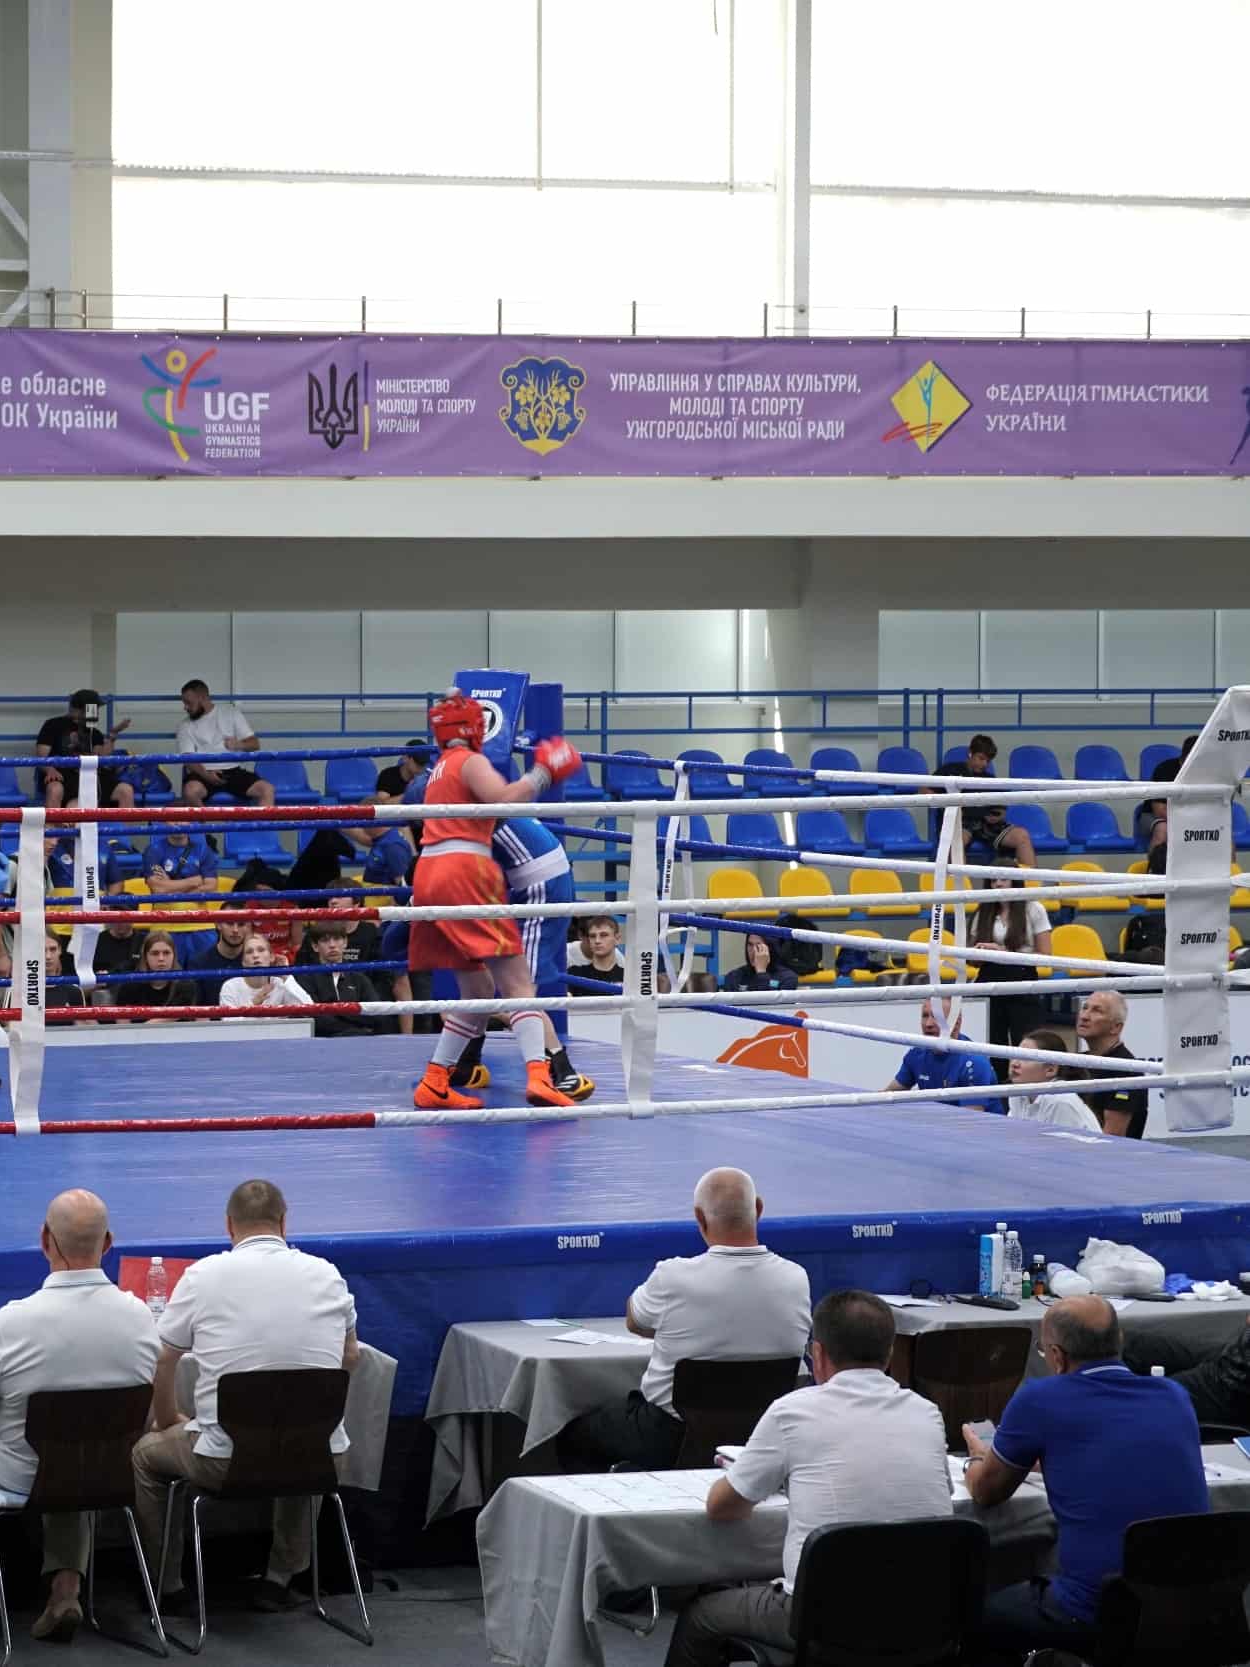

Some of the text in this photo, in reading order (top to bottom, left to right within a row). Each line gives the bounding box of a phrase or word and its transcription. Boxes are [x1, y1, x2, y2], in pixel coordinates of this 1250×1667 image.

[21, 372, 106, 396] обласне
[376, 379, 450, 393] МІНІСТЕРСТВО
[609, 373, 861, 394] УПРАВЛІННЯ У СПРАВАХ КУЛЬТУРИ,
[986, 384, 1209, 405] ФЕДЕРАЦІЯ ГІМНАСТИКИ
[204, 391, 270, 421] UGF
[376, 399, 476, 415] МОЛОДІ ТА СПОРТУ
[669, 398, 804, 418] МОЛОДІ ТА СПОРТУ
[36, 403, 118, 434] України
[376, 416, 420, 432] УКРАЇНИ
[986, 413, 1066, 432] УКРАЇНИ
[205, 423, 260, 434] UKRAINIAN
[626, 418, 845, 441] УЖГОРОДСЬКОЇ МІСЬКОЇ РАДИ
[205, 435, 261, 446] GYMNASTICS
[205, 448, 261, 458] FEDERATION
[1184, 830, 1220, 842] SPORTKO
[1180, 932, 1217, 945] SPORTKO
[640, 952, 653, 996] SPORTKO
[27, 960, 39, 1006] SPORTKO
[1180, 1034, 1219, 1048] SPORTKO
[1142, 1211, 1182, 1225] SPORTKO
[852, 1224, 893, 1238] SPORTKO
[558, 1235, 600, 1249] SPORTKO
